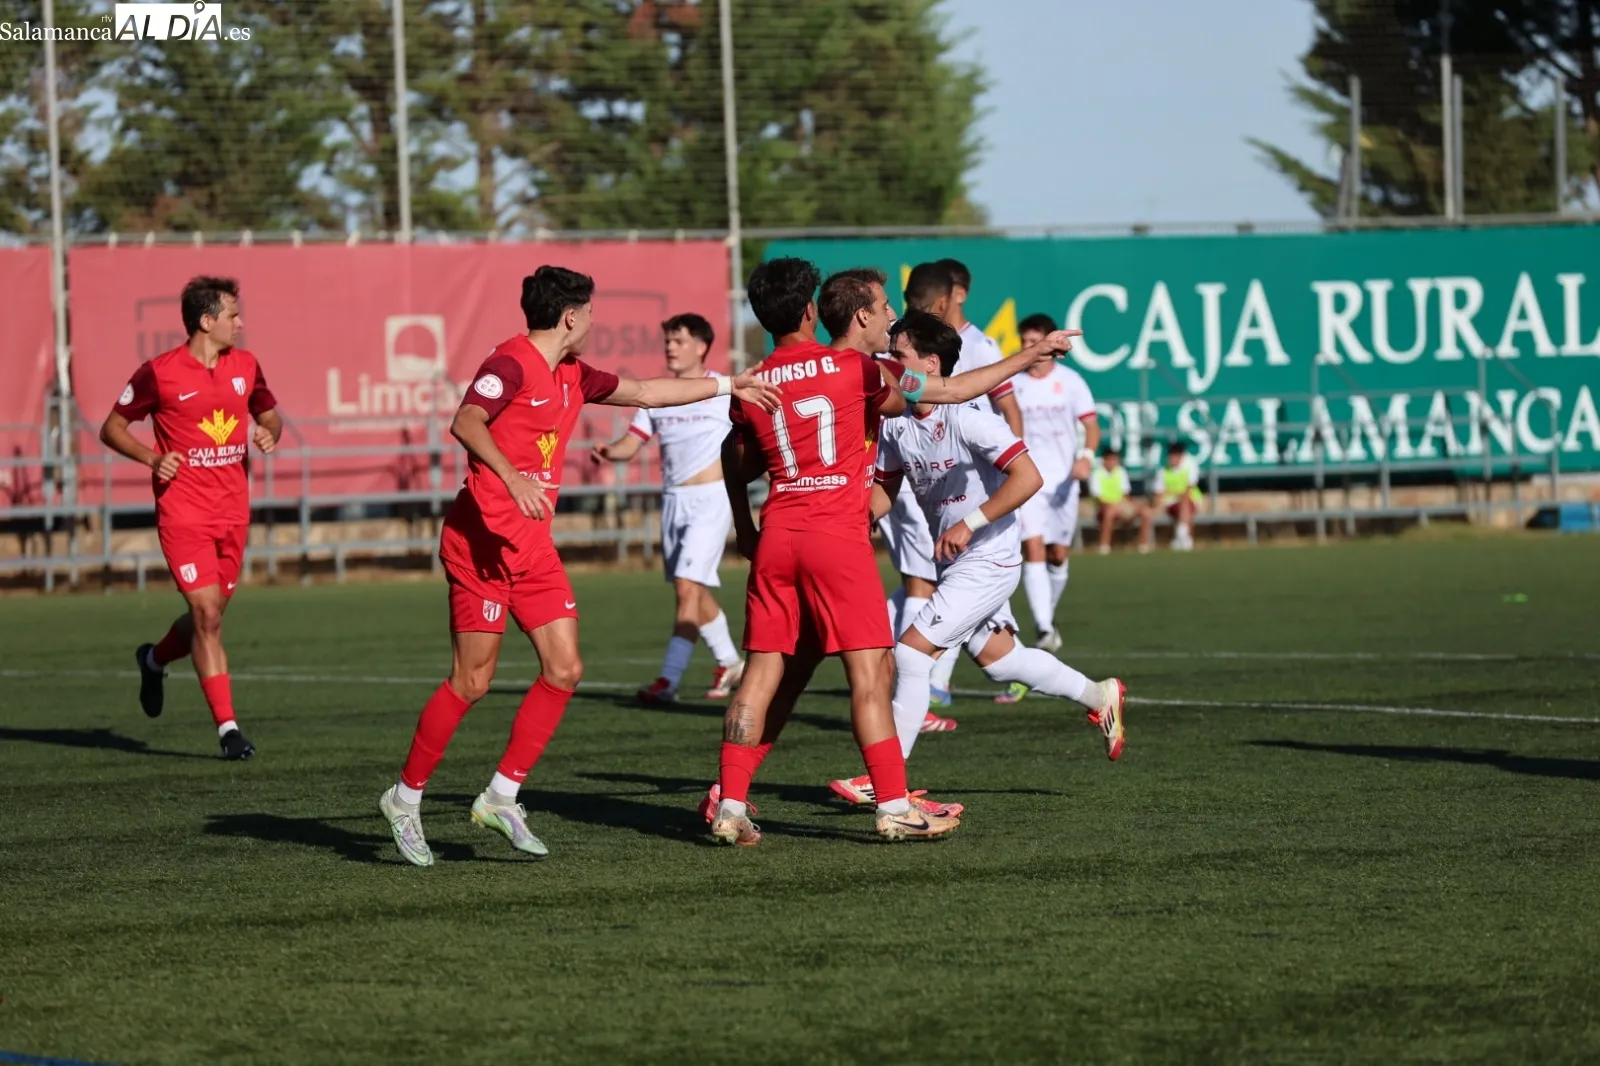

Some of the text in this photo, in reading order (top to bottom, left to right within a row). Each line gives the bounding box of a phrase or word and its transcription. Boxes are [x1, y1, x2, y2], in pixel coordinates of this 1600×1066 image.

[1065, 271, 1600, 393] CAJA RURAL
[821, 356, 841, 374] G.
[771, 394, 837, 479] 17
[1177, 384, 1600, 466] SALAMANCA
[188, 443, 246, 460] CAJA RURAL
[903, 458, 957, 473] SPIRE
